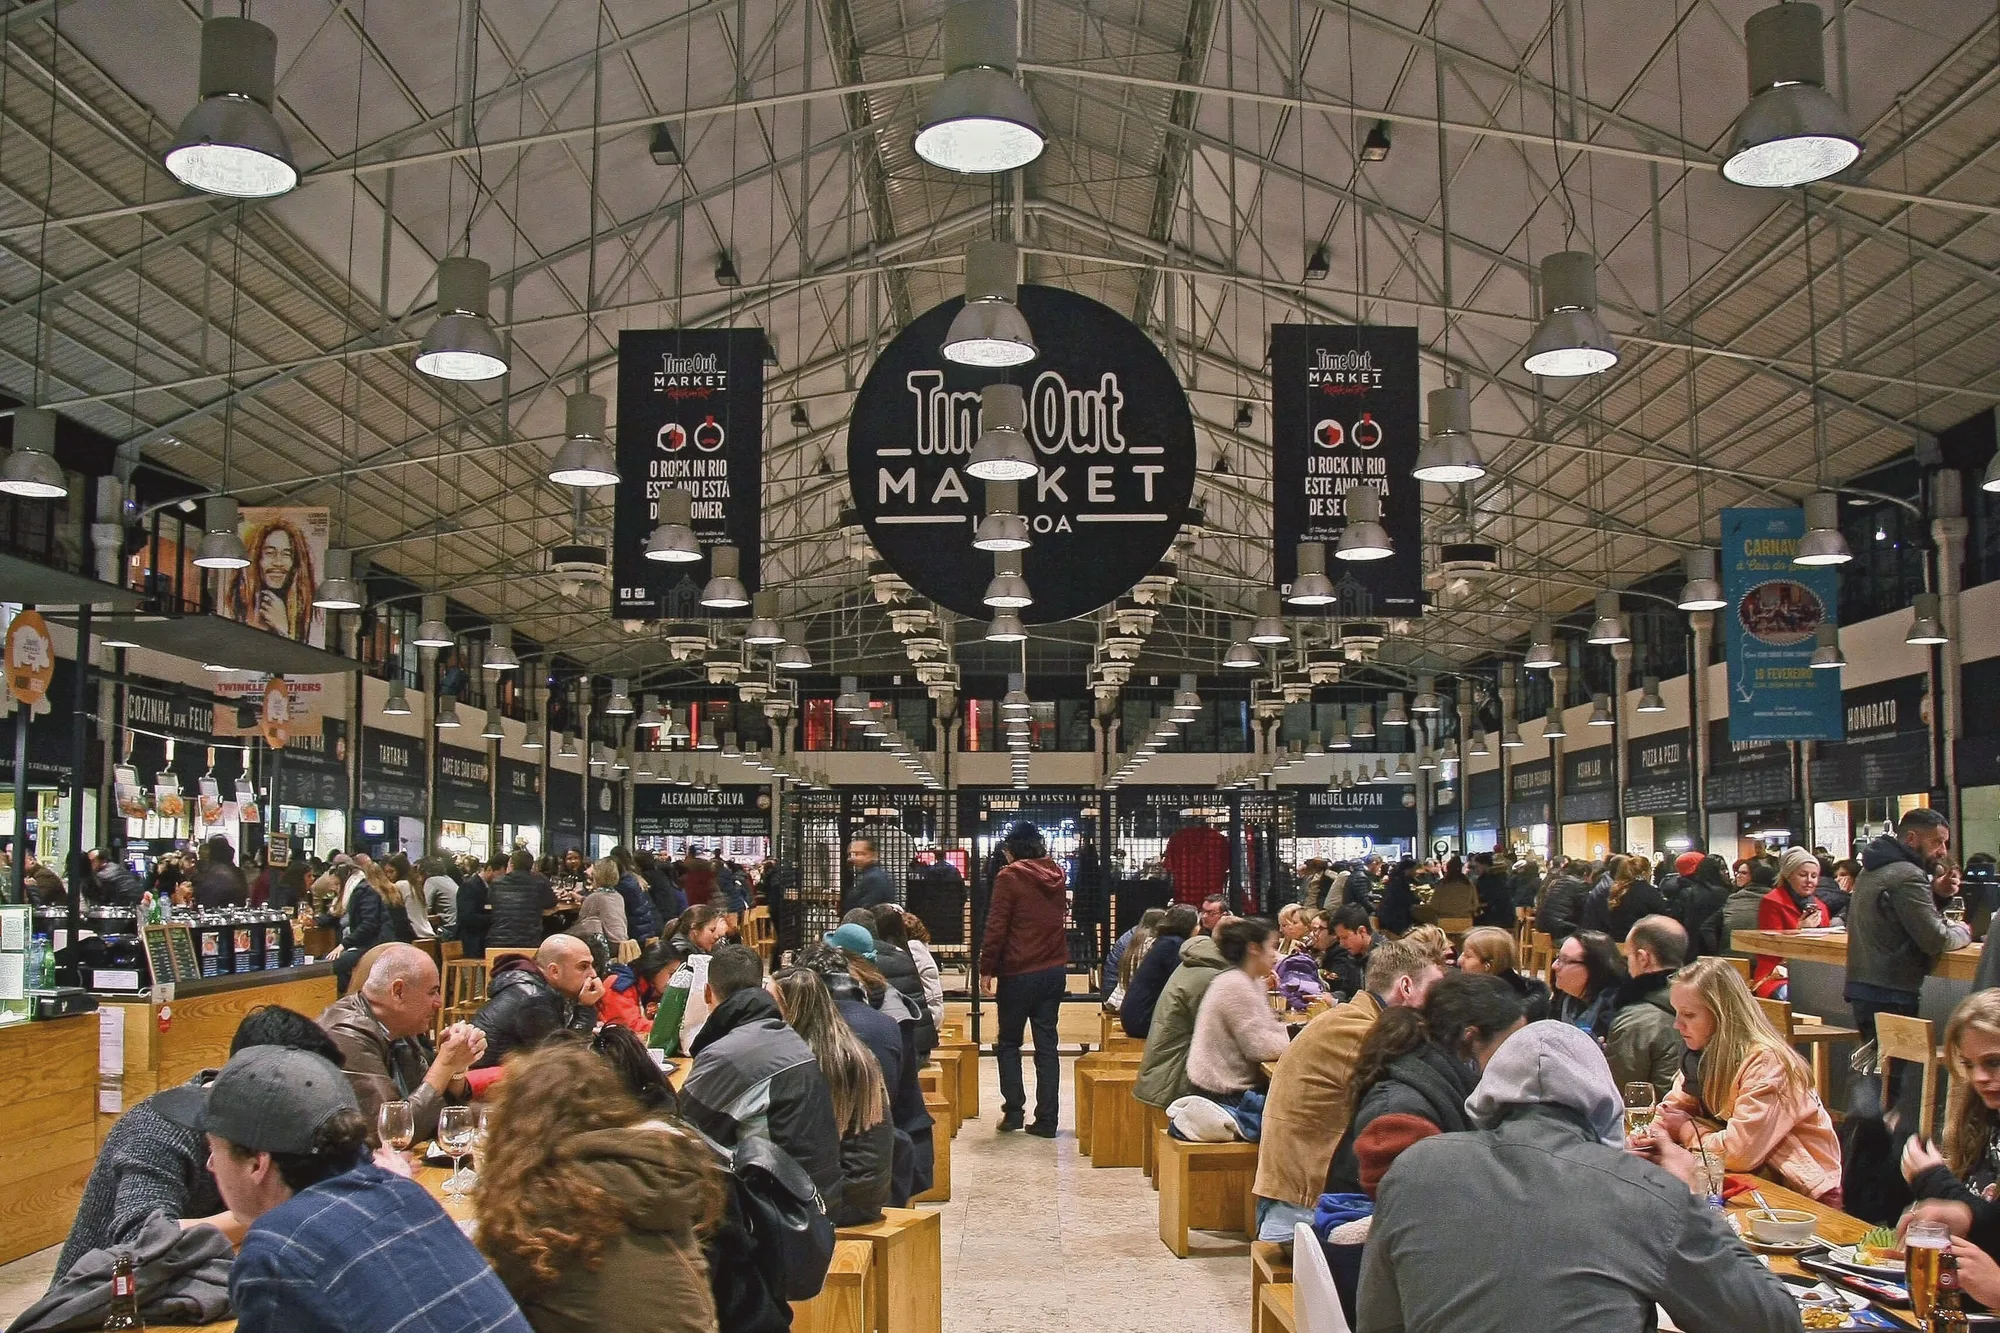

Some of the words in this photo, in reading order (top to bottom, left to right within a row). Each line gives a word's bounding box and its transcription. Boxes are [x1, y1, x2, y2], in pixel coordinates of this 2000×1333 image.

[662, 353, 693, 374] Time
[694, 353, 718, 374] Out
[1316, 348, 1347, 370] Time
[1348, 349, 1371, 371] Out
[654, 375, 727, 387] MARKET
[1309, 372, 1382, 384] MARKET
[907, 369, 1027, 455] Tim
[1031, 370, 1125, 455] Out
[650, 460, 658, 478] O
[660, 460, 691, 478] ROCK
[693, 460, 706, 478] IN
[708, 459, 727, 478] RIO
[1308, 456, 1316, 473] O
[1318, 457, 1349, 474] ROCK
[1352, 457, 1364, 475] IN
[1367, 458, 1386, 475] RIO
[702, 477, 731, 498] ESTÁ
[878, 466, 1165, 504] MAKET
[1305, 476, 1332, 495] ESTE
[1363, 475, 1390, 496] STÁ
[691, 502, 726, 519] OMER.
[1310, 498, 1324, 516] DE
[1326, 498, 1341, 517] SE
[1744, 538, 1801, 557] CARNAV
[216, 682, 265, 692] TWINKLE
[286, 682, 322, 692] THERS
[128, 694, 171, 726] COZINHA
[1847, 699, 1897, 732] HONORATO
[379, 744, 409, 767] TARTAR-IA
[1642, 748, 1658, 768] PIZZA
[1658, 747, 1663, 765] A
[1664, 743, 1680, 763] PEZZI
[442, 756, 454, 775] CAFÉ
[454, 760, 460, 776] DE
[661, 793, 714, 805] ALEXANDRE
[717, 793, 744, 805] SILVA
[1309, 793, 1344, 806] MIGUEL
[1347, 793, 1383, 806] LAFFAN
